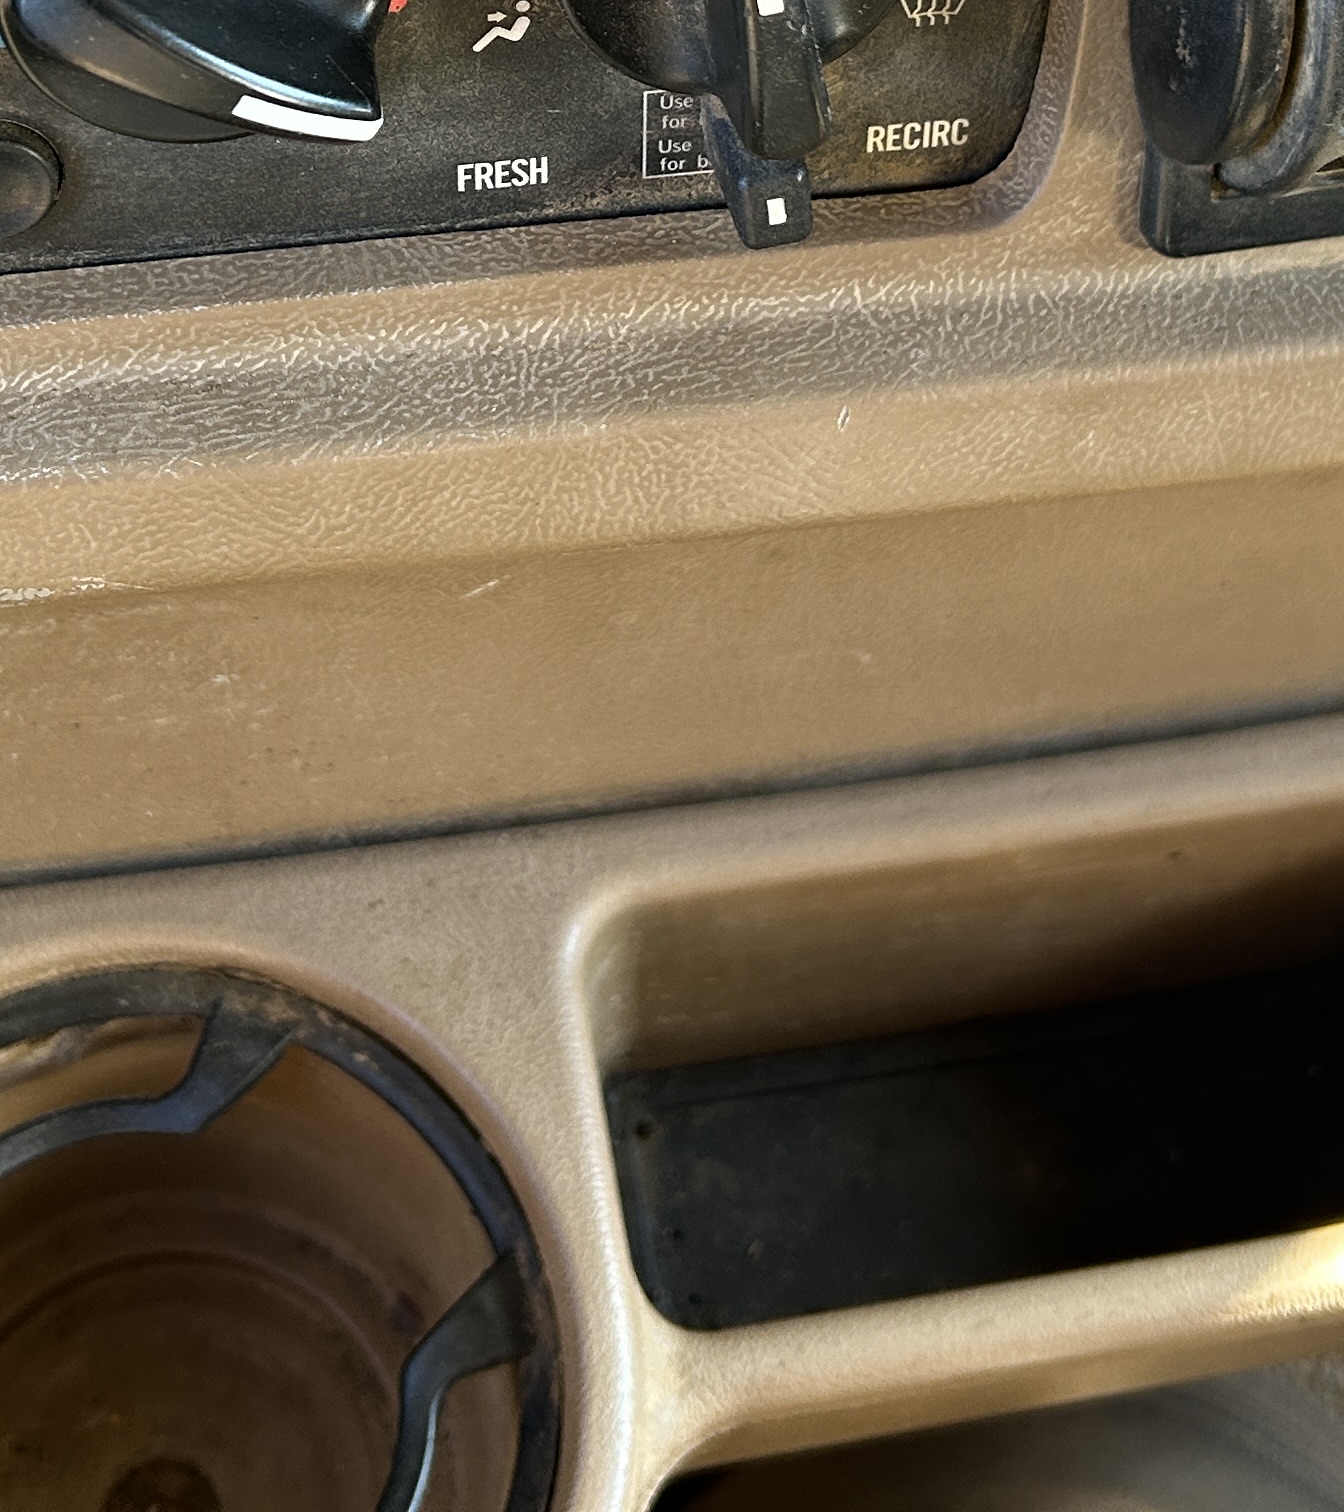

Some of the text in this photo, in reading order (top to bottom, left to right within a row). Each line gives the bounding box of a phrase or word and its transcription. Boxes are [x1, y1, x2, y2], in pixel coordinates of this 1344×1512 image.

[659, 93, 694, 110] Use
[661, 114, 688, 129] for
[865, 117, 970, 154] RECIRC
[657, 138, 692, 154] Use
[660, 156, 686, 172] for
[457, 156, 549, 193] FRESH
